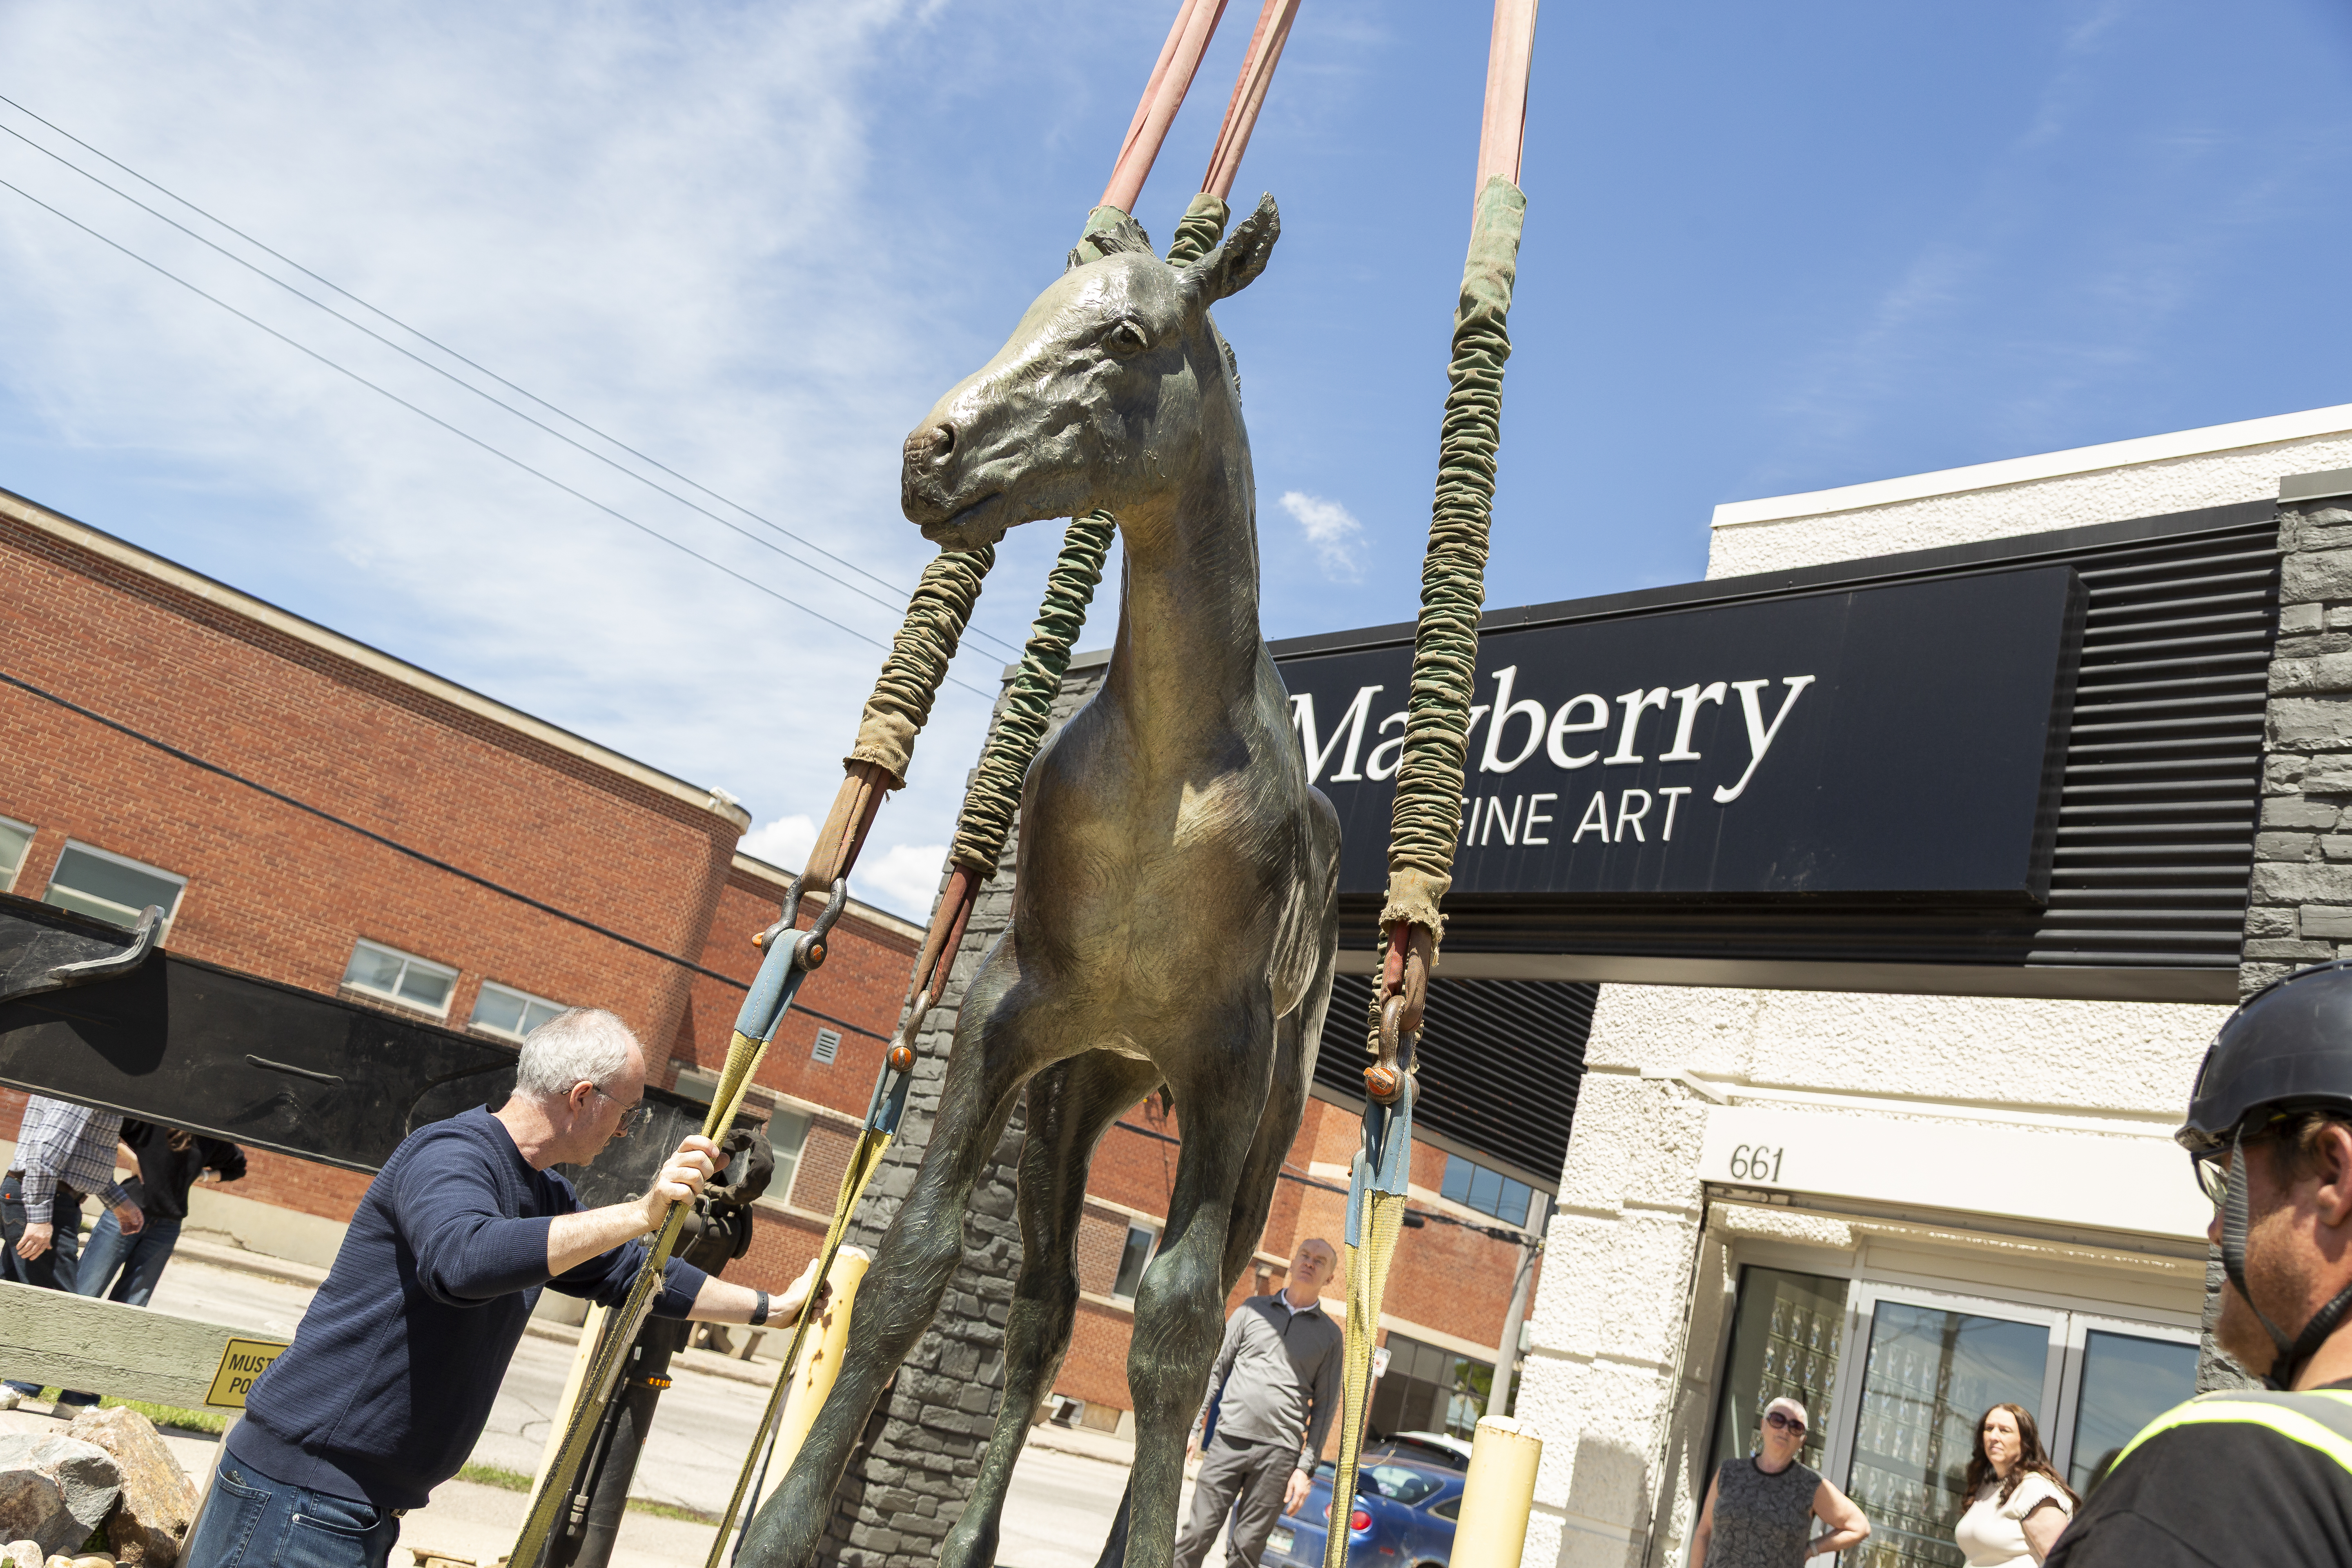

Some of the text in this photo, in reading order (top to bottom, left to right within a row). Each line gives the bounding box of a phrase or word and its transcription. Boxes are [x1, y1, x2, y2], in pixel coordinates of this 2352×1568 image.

[1290, 664, 1816, 803] Maberry
[1457, 786, 1692, 846] INE ART
[1731, 1144, 1784, 1182] 661
[228, 1353, 276, 1373] MUST
[228, 1376, 256, 1394] PO
